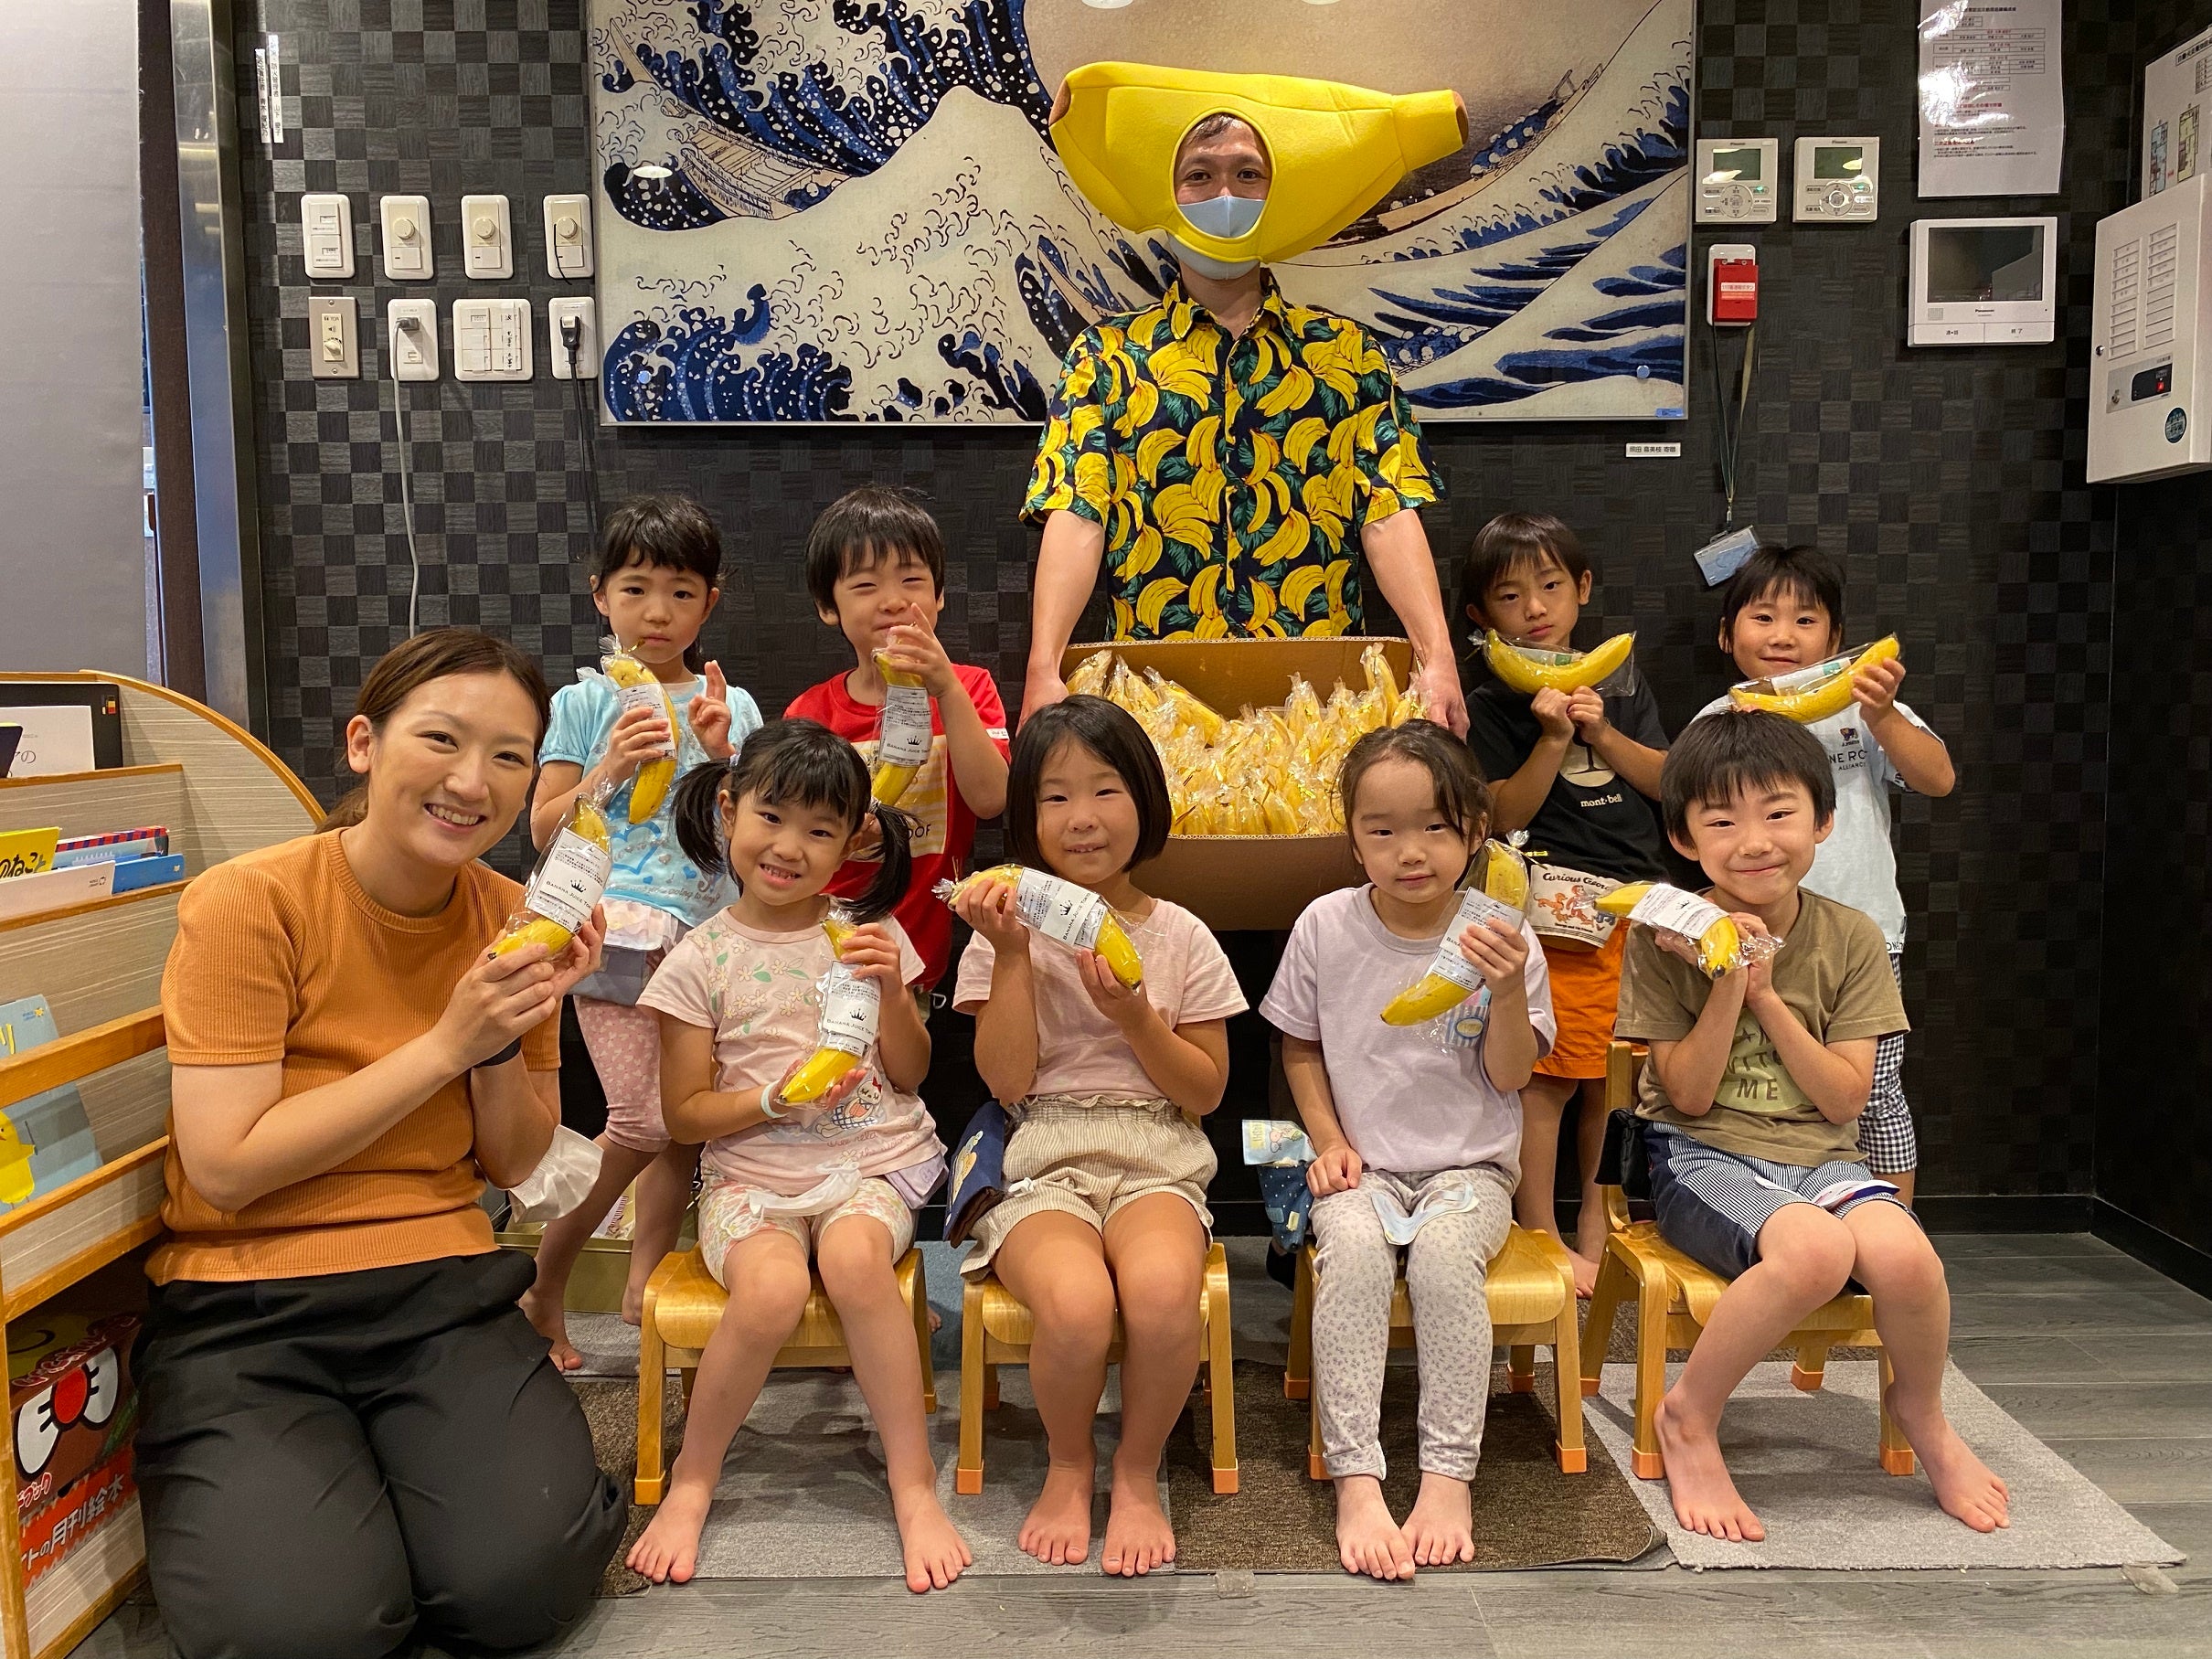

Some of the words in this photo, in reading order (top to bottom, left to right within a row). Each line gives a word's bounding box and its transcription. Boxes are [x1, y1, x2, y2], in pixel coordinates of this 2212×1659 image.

[1543, 872, 1581, 883] Curious
[546, 880, 569, 895] BANANA
[569, 892, 583, 904] JUICE
[1063, 918, 1075, 941] BANANA
[826, 1017, 850, 1027] BANANA
[850, 1021, 865, 1032] JUICE
[1737, 1078, 1778, 1101] ME
